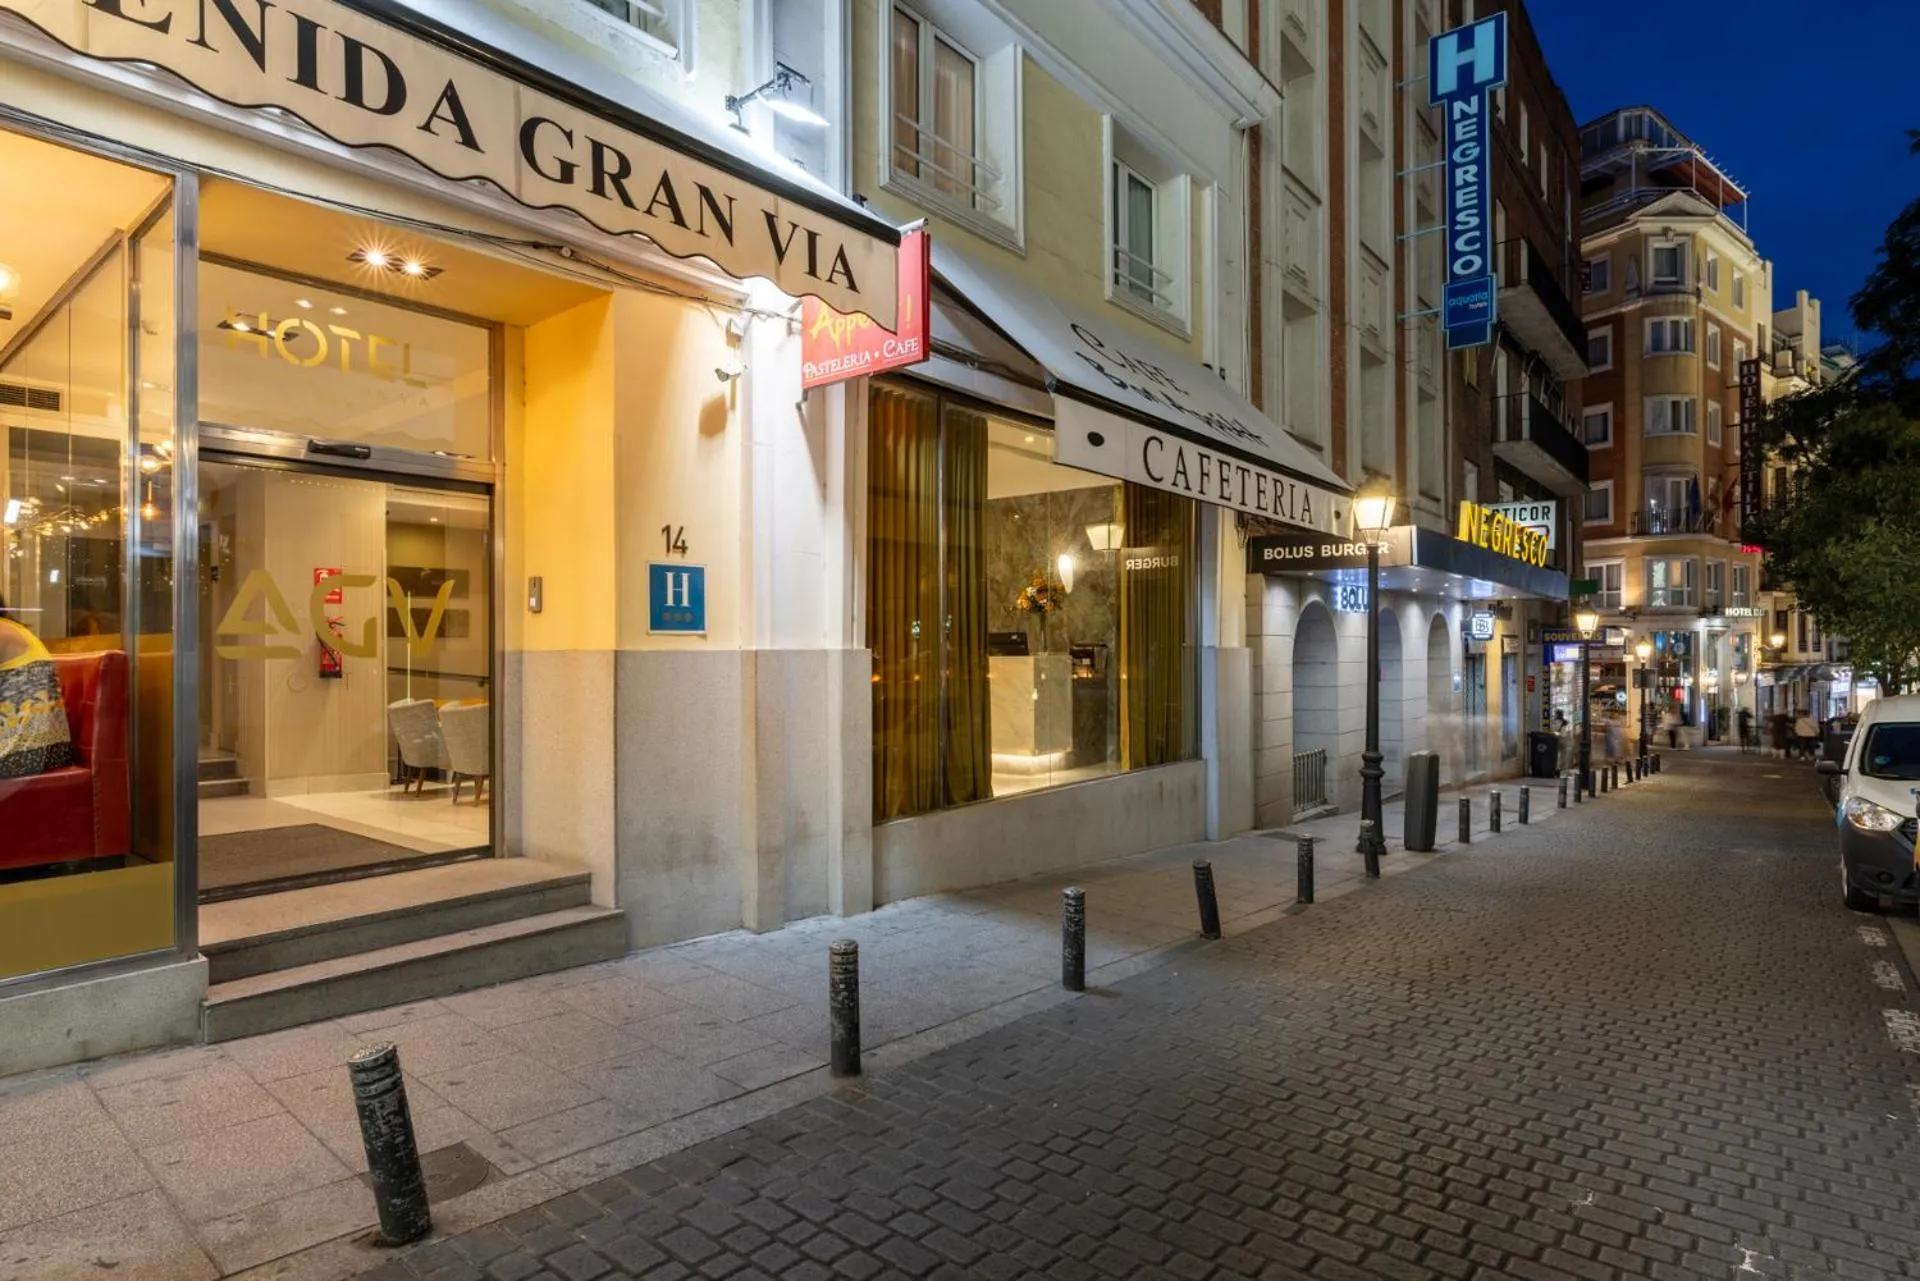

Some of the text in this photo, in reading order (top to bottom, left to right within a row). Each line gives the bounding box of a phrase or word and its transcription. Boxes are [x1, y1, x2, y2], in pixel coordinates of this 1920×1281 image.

[1437, 20, 1495, 95] H
[81, 0, 861, 295] NIDA GRAN VIA
[1452, 95, 1483, 275] NEGRESCO
[226, 306, 428, 388] HOTEL
[803, 337, 920, 379] PASTELERIA CAFE
[1742, 364, 1757, 419] HOTEL
[1143, 436, 1313, 524] CAFETERIA
[661, 524, 688, 557] 14
[1263, 541, 1389, 560] BOLUS BURGR
[1456, 501, 1548, 568] NEGRESCO
[664, 571, 691, 607] H
